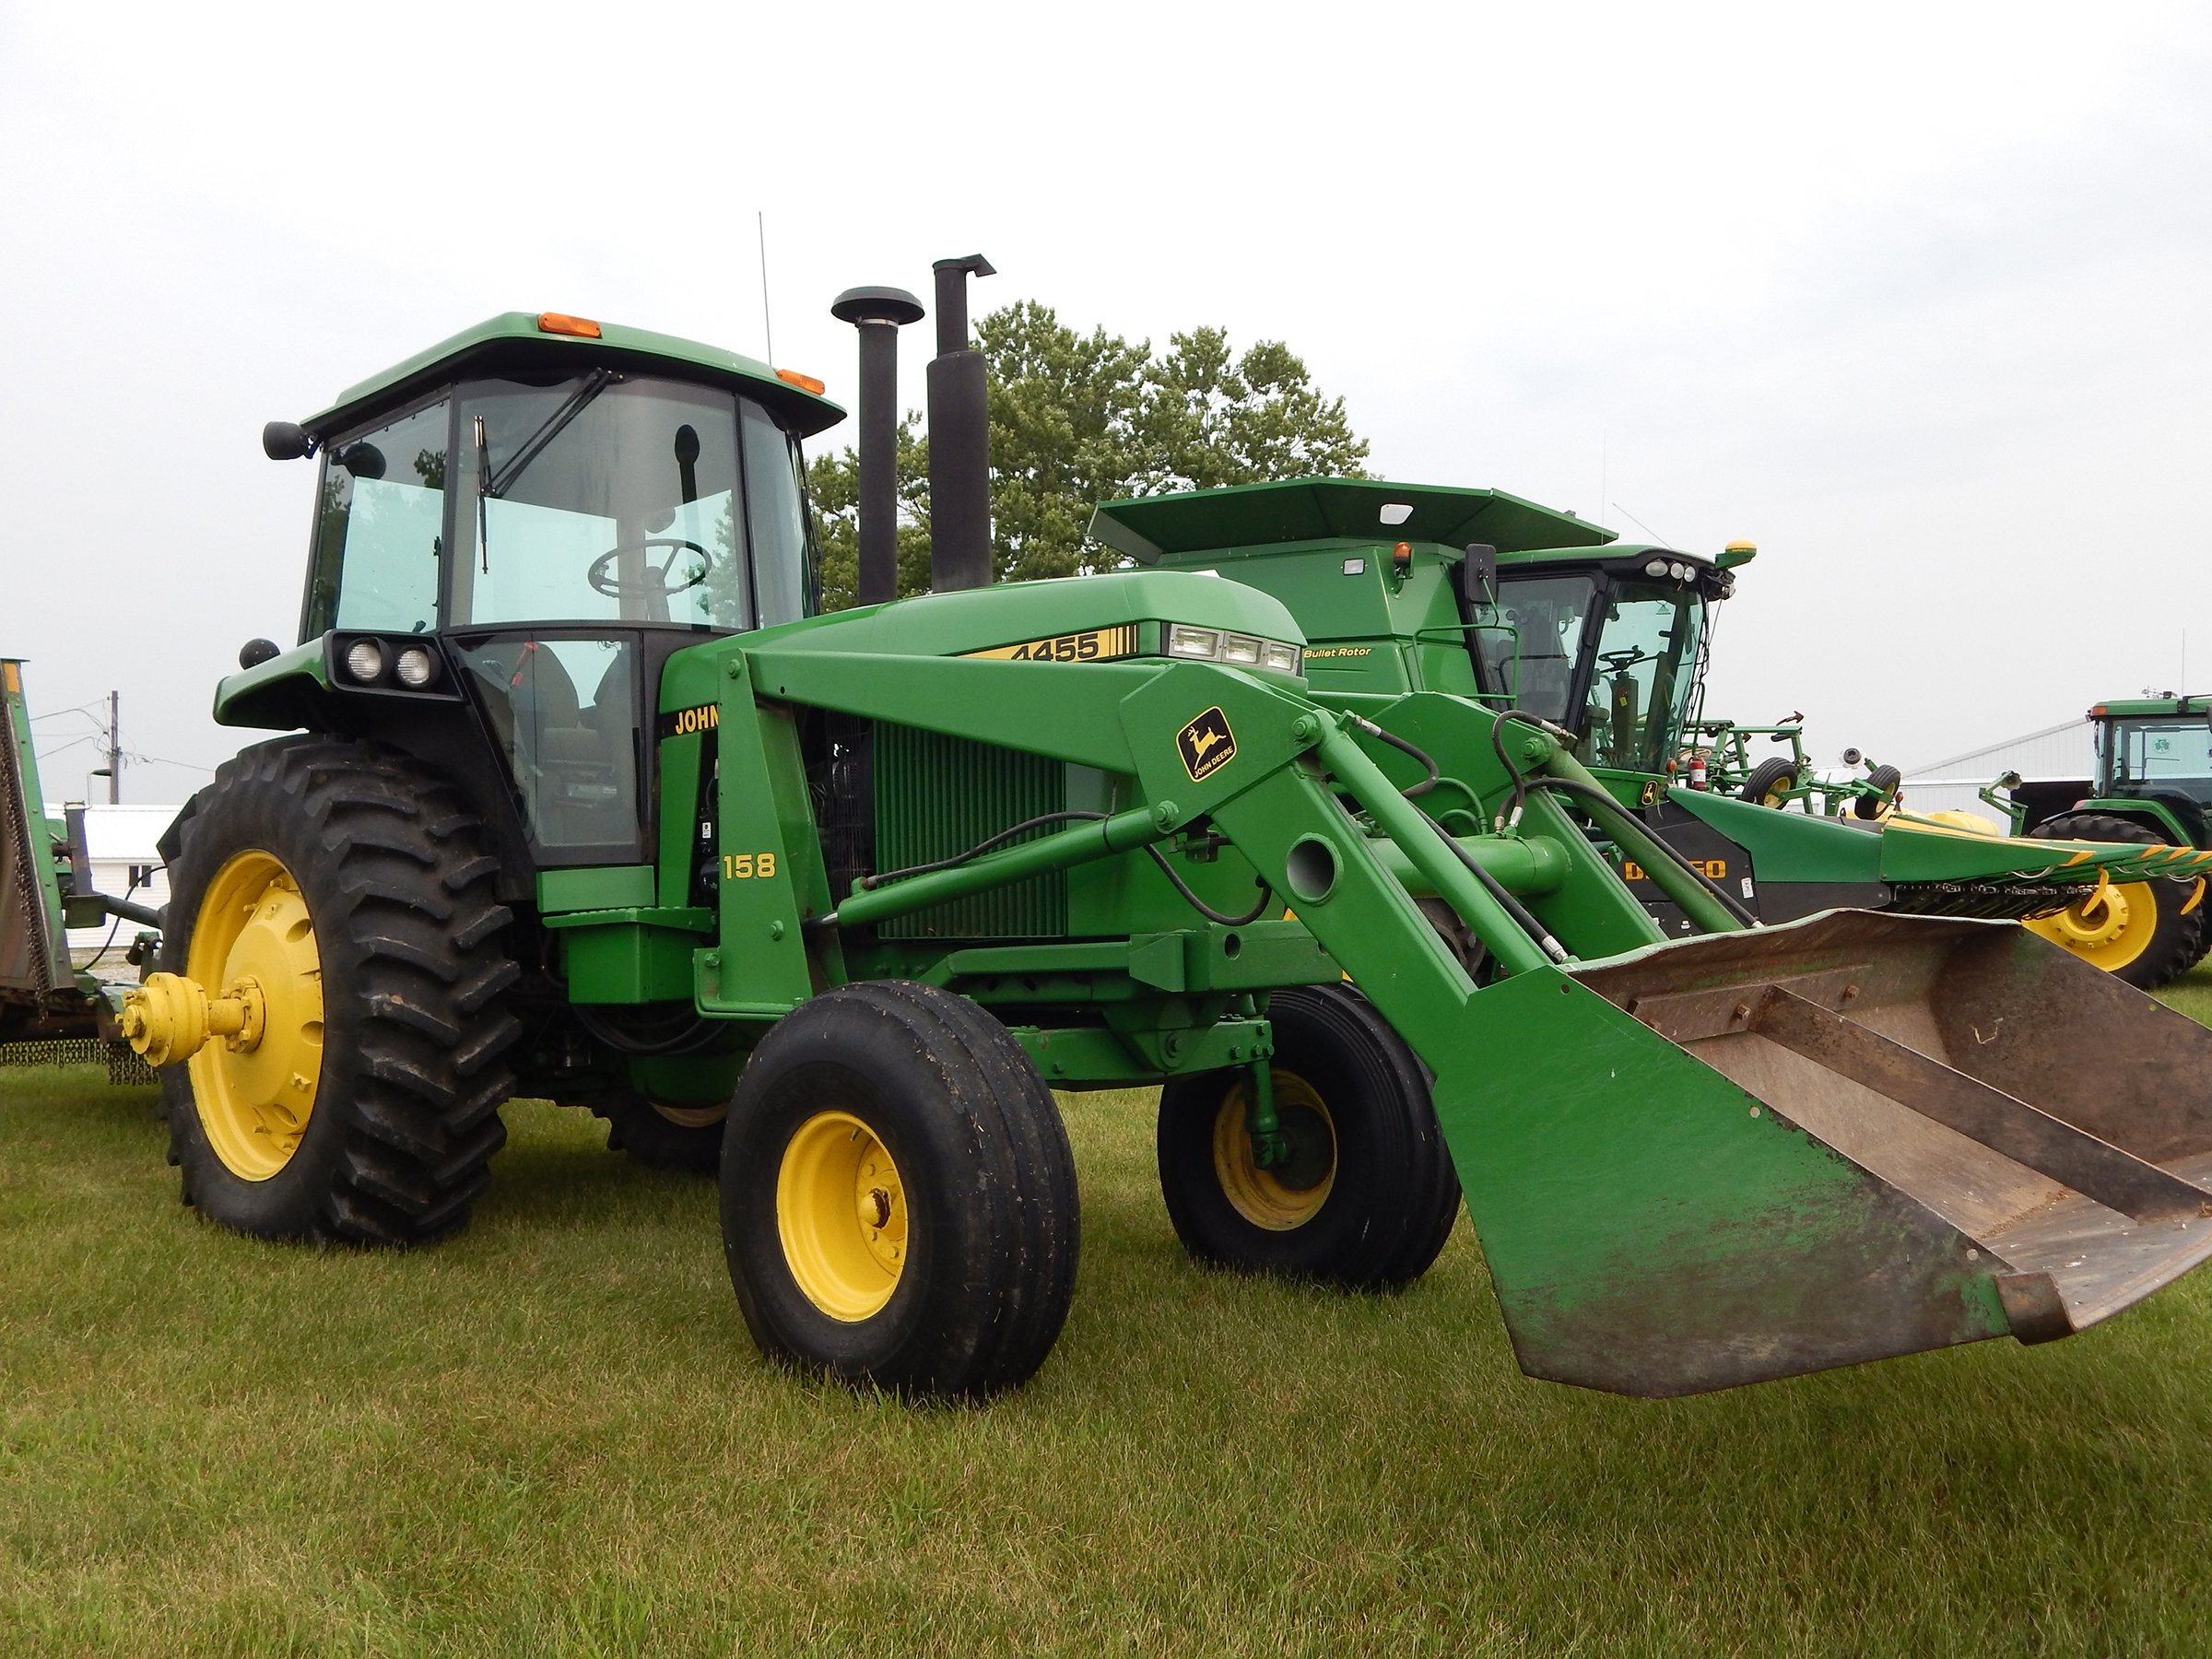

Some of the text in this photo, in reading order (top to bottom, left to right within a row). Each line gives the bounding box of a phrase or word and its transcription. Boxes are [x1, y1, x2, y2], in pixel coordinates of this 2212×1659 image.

[1010, 632, 1100, 662] 4455
[1303, 647, 1372, 658] Bullet Rotor
[1194, 745, 1234, 778] JOHN DEERE
[723, 853, 777, 879] 158
